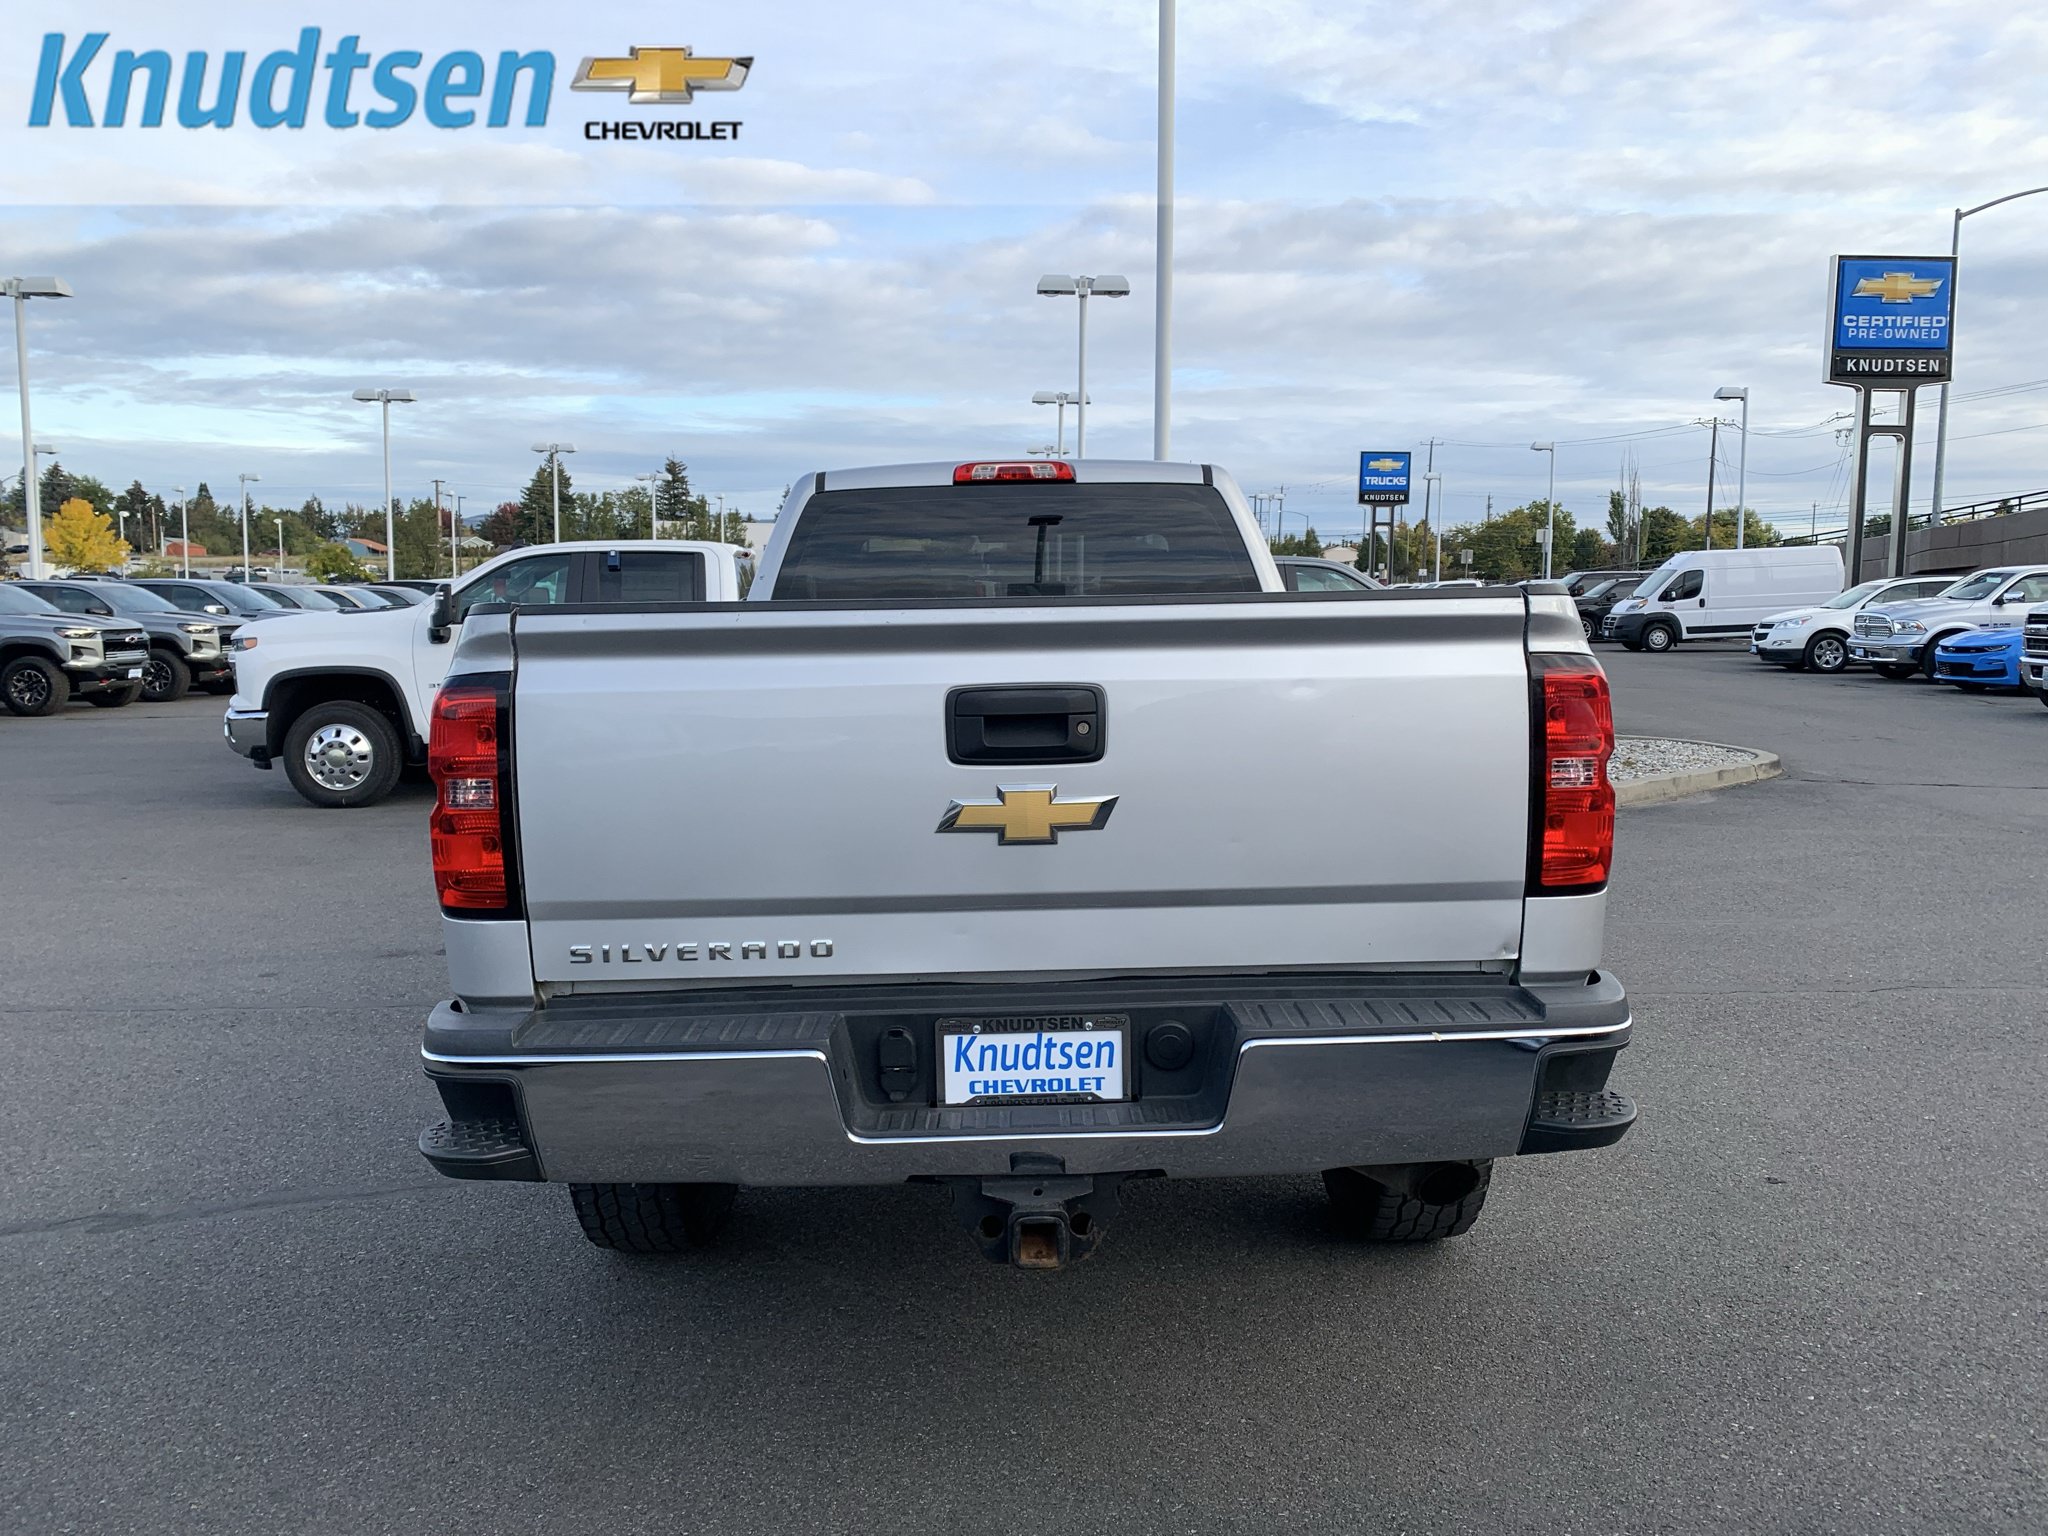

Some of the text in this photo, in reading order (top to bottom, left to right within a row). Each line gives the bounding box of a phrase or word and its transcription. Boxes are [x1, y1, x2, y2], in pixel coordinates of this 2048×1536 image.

[1843, 315, 1947, 327] CERTIFIED
[1848, 328, 1940, 339] PRE-OWNED
[1846, 358, 1940, 372] KNUDTSEN
[1364, 476, 1407, 485] TRUCKS
[569, 939, 834, 964] SILVERADO
[982, 1017, 1084, 1032] KNUDTSEN
[954, 1032, 1115, 1073] Knudtsen
[968, 1077, 1106, 1094] CHEVROLET
